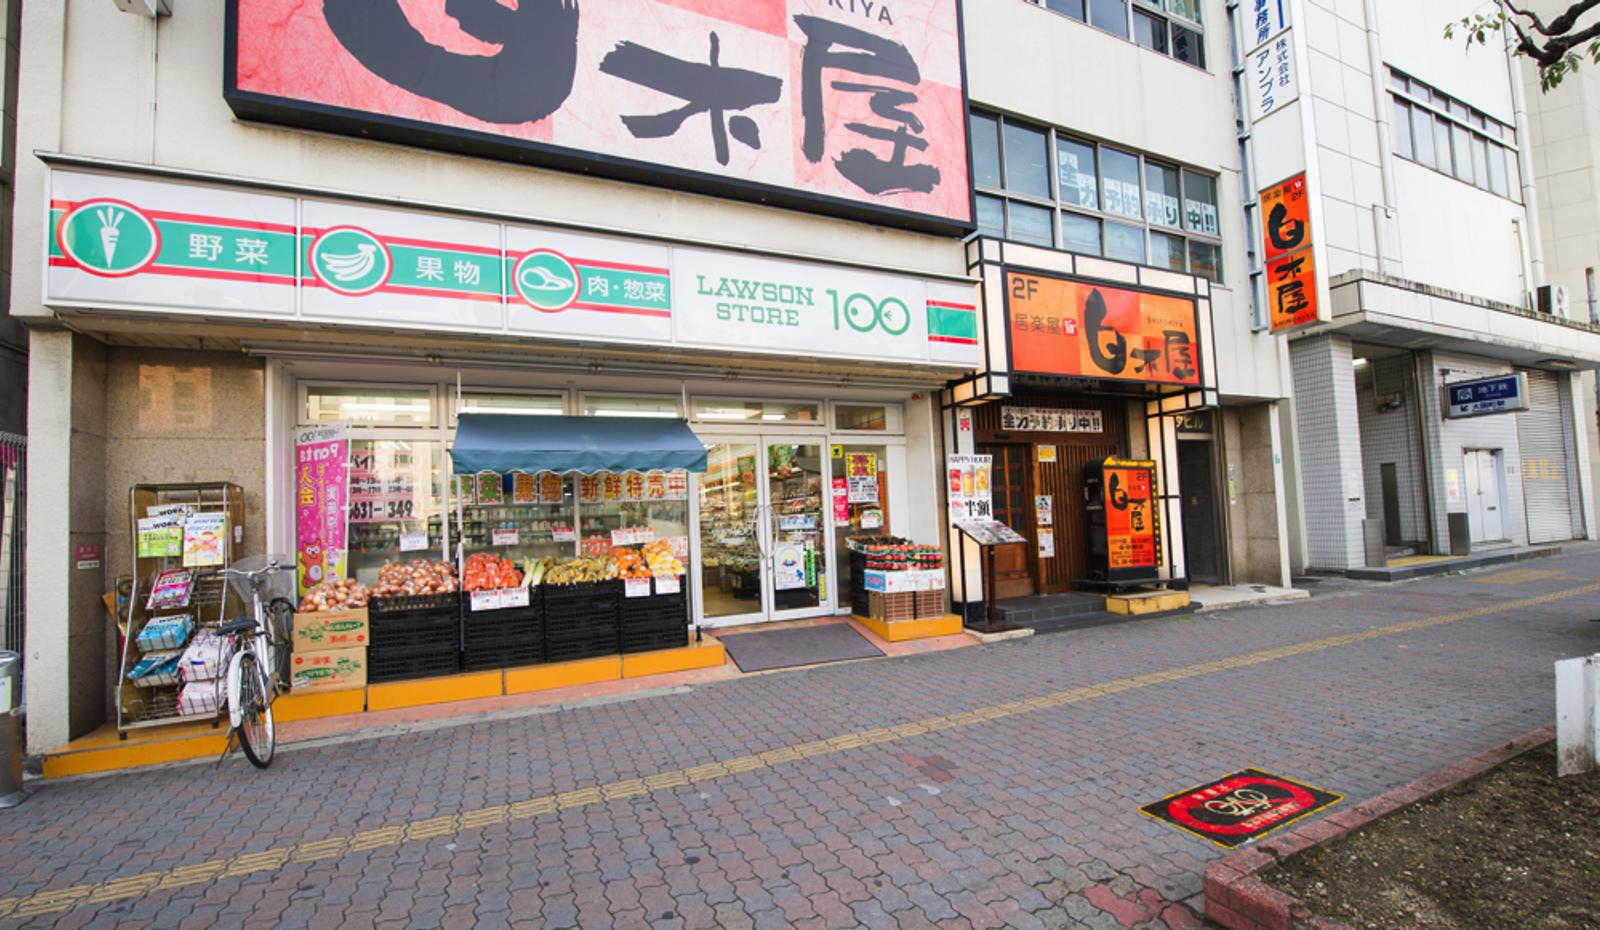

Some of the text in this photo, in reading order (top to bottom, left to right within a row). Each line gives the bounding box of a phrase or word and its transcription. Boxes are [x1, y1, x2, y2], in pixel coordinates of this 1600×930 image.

[1256, 48, 1275, 113] アンプラ
[188, 232, 270, 266] 野菜
[415, 256, 481, 285] 果物
[696, 274, 815, 306] LAWSON
[1011, 277, 1039, 300] 2F
[716, 302, 800, 327] STORE
[826, 288, 911, 337] 100
